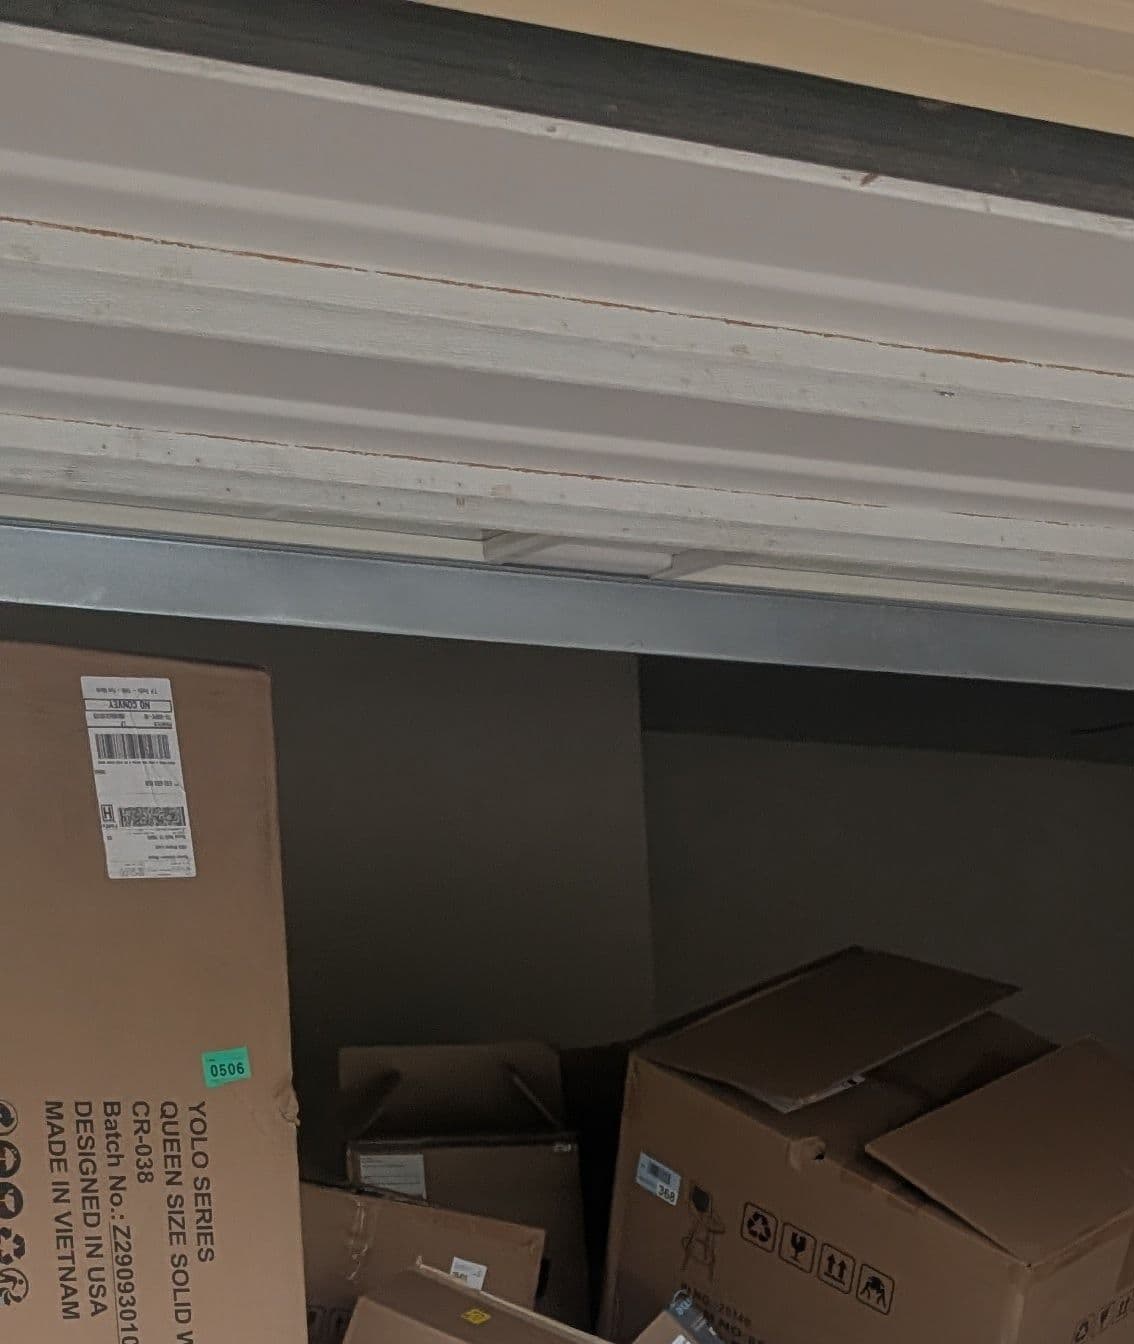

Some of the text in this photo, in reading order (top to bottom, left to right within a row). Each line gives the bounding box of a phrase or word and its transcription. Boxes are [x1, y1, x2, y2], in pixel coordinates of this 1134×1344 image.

[210, 1062, 245, 1078] 0506
[103, 1100, 126, 1168] Batch
[132, 1100, 154, 1184] CR-038
[160, 1100, 183, 1187] QUEEN
[45, 1100, 80, 1320] MADE IN VIETNAM
[74, 1100, 108, 1318] DESIGNED IN USA
[166, 1194, 187, 1246] SIZE
[188, 1100, 215, 1263] YOLO SERIES
[170, 1253, 193, 1325] SOLID
